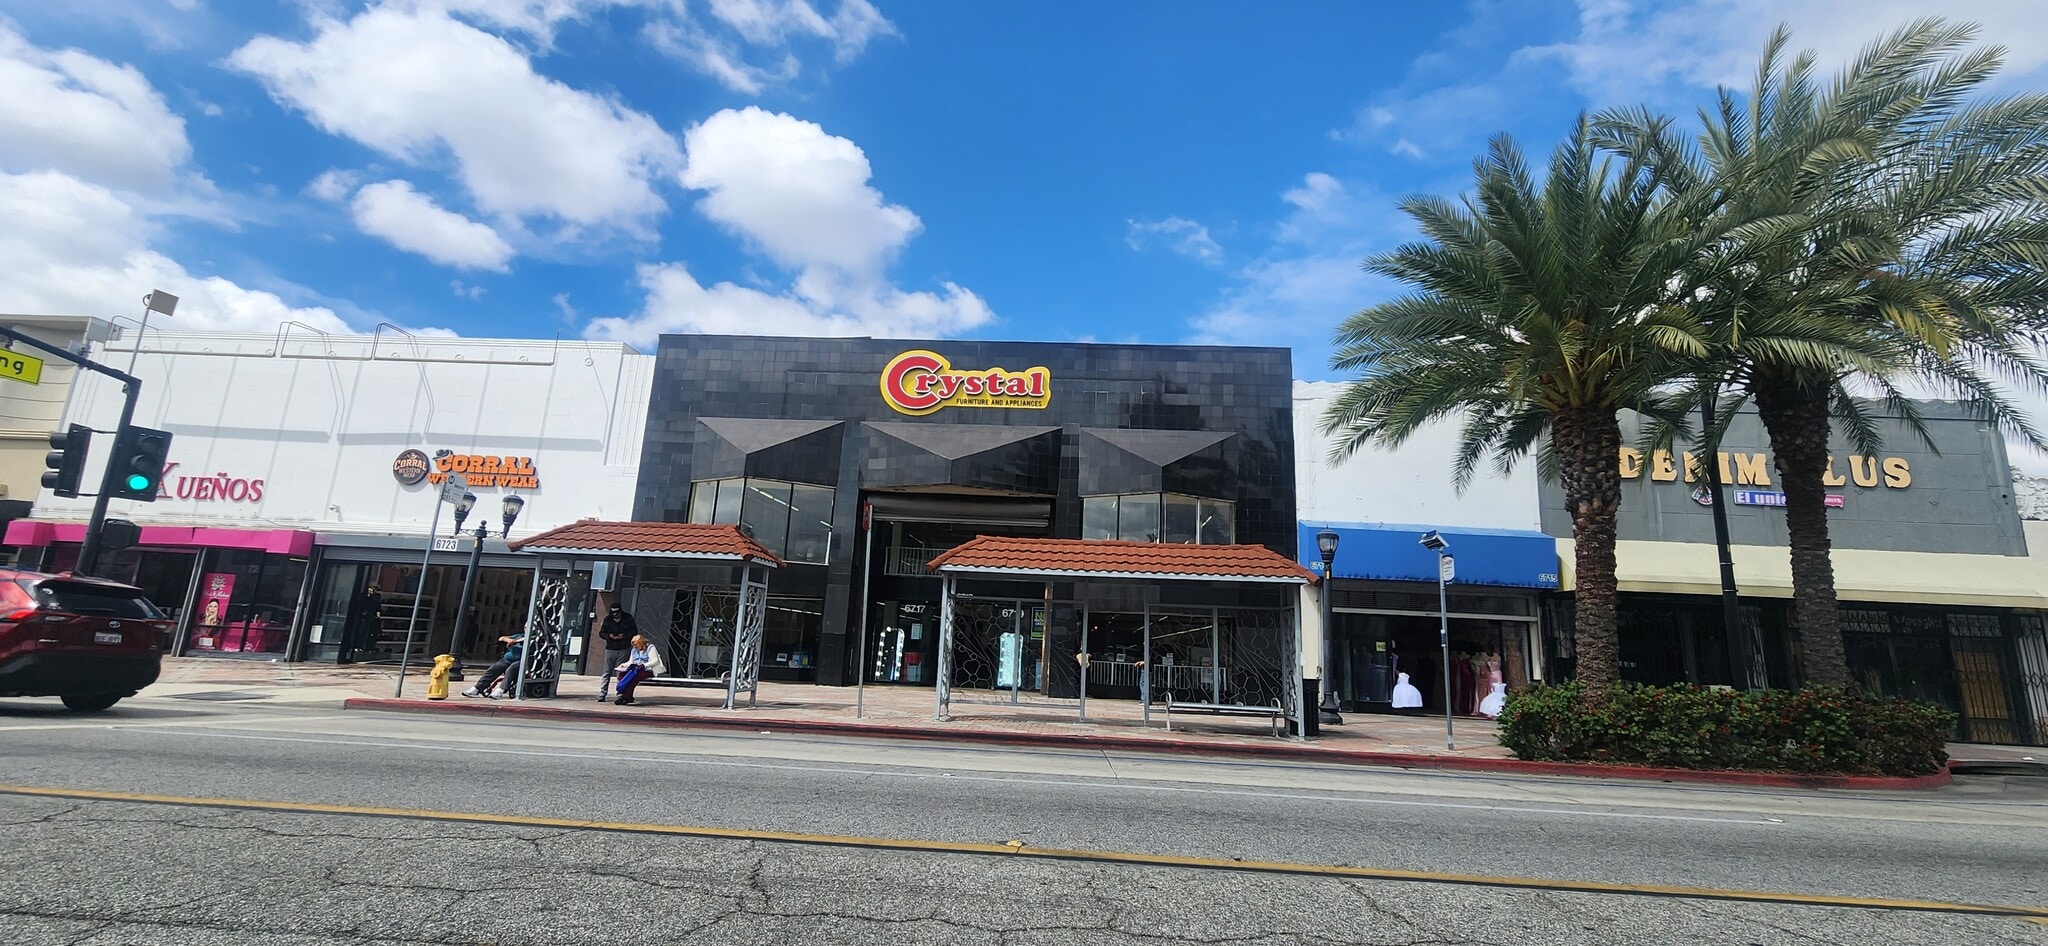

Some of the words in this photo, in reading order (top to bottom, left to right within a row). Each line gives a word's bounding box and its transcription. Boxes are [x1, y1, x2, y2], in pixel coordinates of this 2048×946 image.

[886, 354, 1044, 410] Crystal
[956, 398, 989, 406] FURNITURE
[1005, 399, 1042, 407] APPLIANCES
[394, 459, 427, 471] CORRAL
[436, 454, 535, 476] CORRAL
[1822, 454, 1912, 488] LUS
[427, 473, 494, 487] WEERN
[496, 476, 539, 489] WEAR
[1736, 491, 1750, 503] El
[435, 540, 457, 550] 6723
[1538, 573, 1558, 582] 6715
[904, 604, 926, 614] 6717
